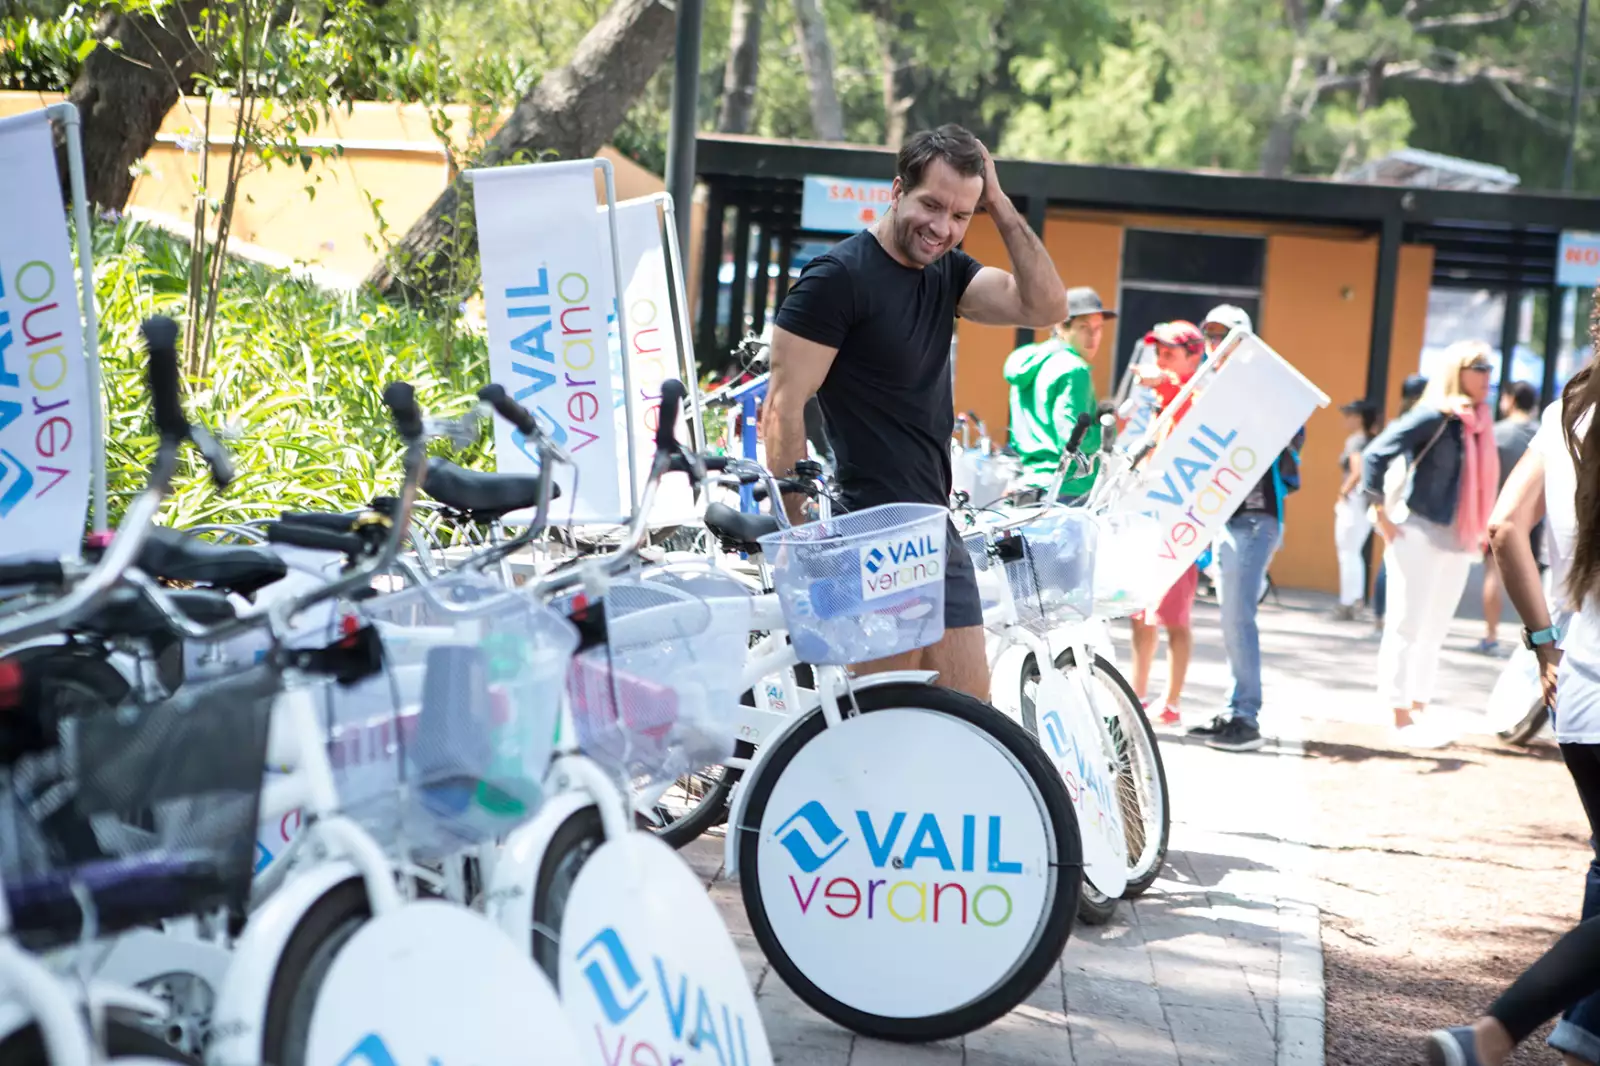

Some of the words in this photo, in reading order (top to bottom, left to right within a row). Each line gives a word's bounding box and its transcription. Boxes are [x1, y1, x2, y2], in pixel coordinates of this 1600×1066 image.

[829, 184, 892, 203] SALID
[505, 267, 557, 401] VAIL
[557, 272, 600, 453] verano
[15, 260, 73, 499] verano
[630, 299, 666, 459] erano
[1146, 423, 1238, 507] VAIL
[1158, 446, 1257, 561] verano
[866, 560, 940, 593] verano
[888, 534, 939, 565] VAIL
[855, 810, 1023, 874] VAIL
[789, 875, 1013, 927] verano
